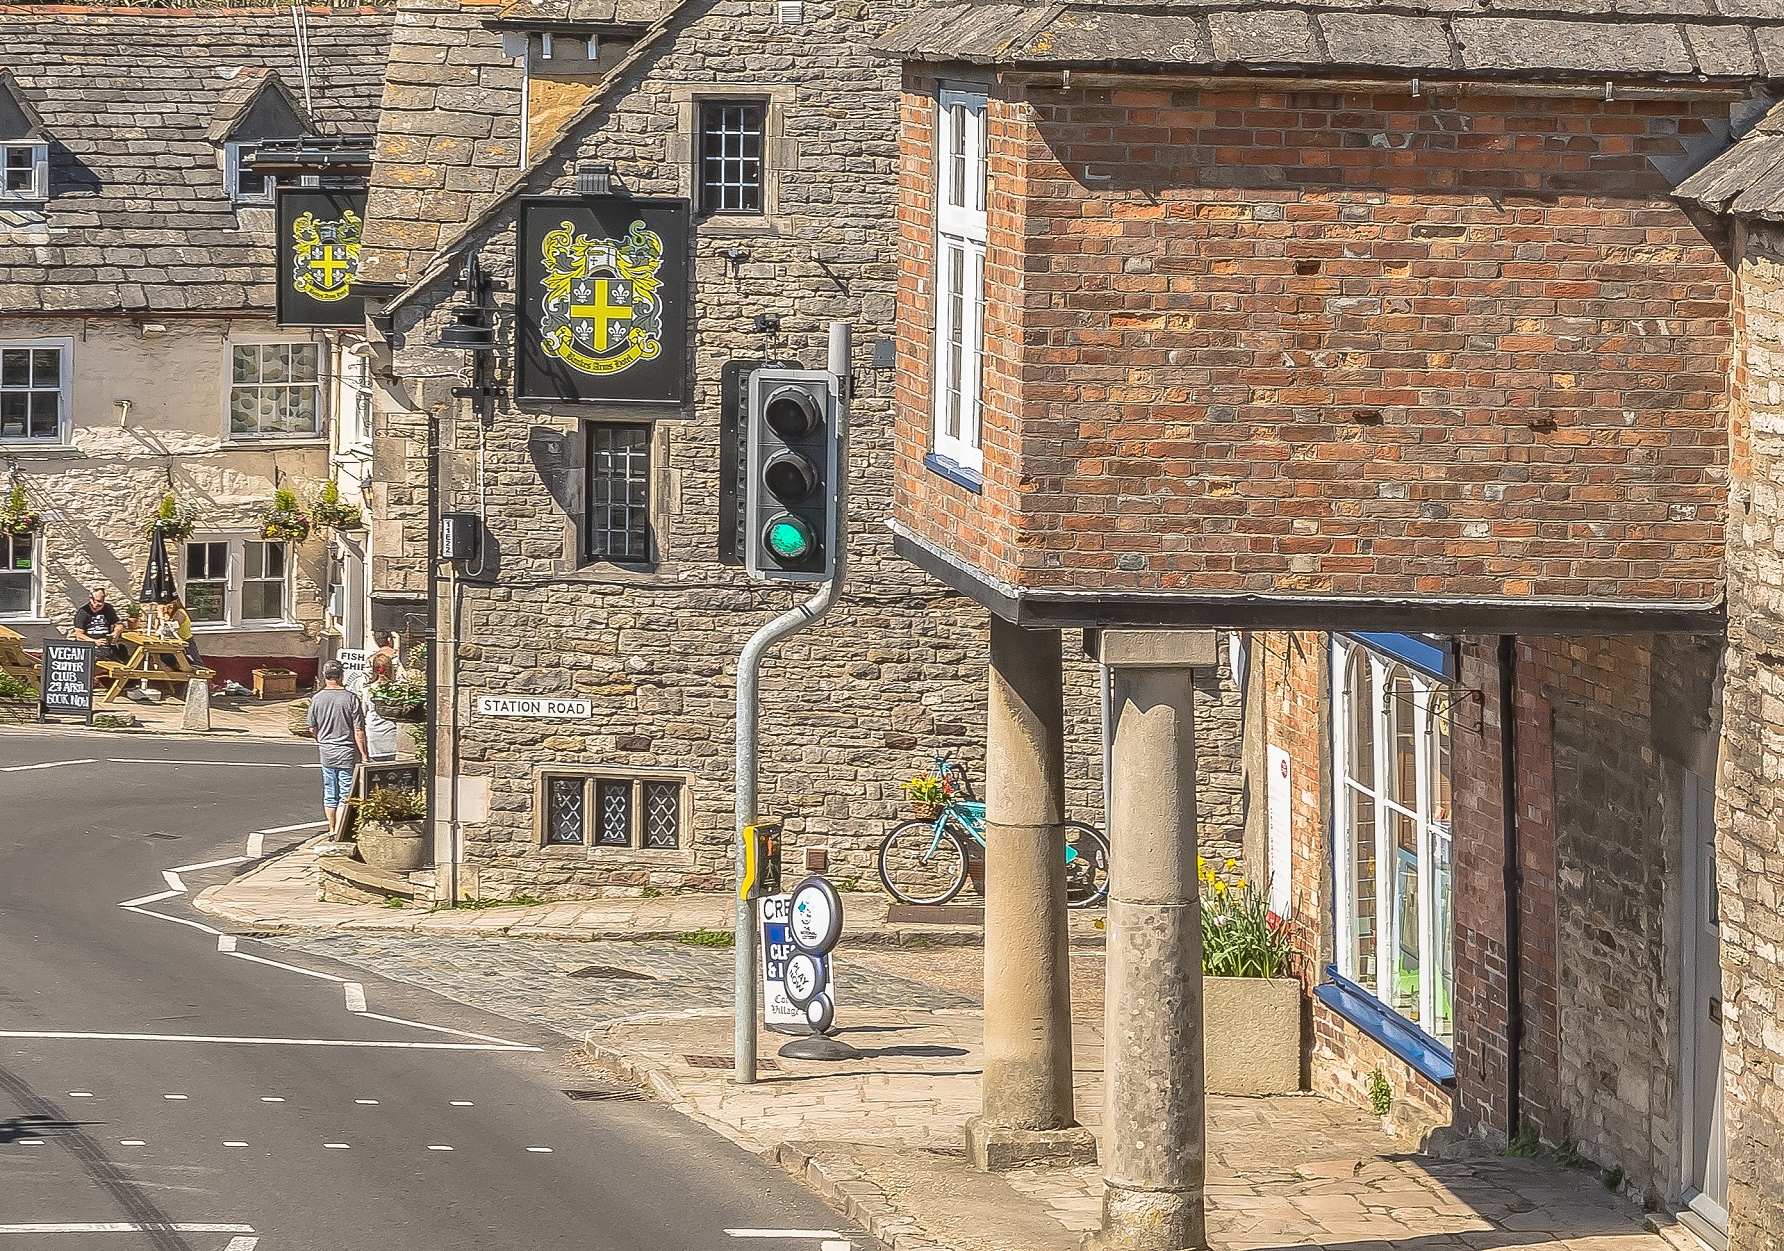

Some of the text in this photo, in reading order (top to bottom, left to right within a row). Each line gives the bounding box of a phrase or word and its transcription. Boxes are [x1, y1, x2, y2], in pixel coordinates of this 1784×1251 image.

[48, 646, 86, 660] VEGAN
[341, 652, 365, 661] FISH
[51, 671, 77, 682] CLUB
[484, 699, 585, 715] STATION ROAD
[763, 898, 792, 920] CRE
